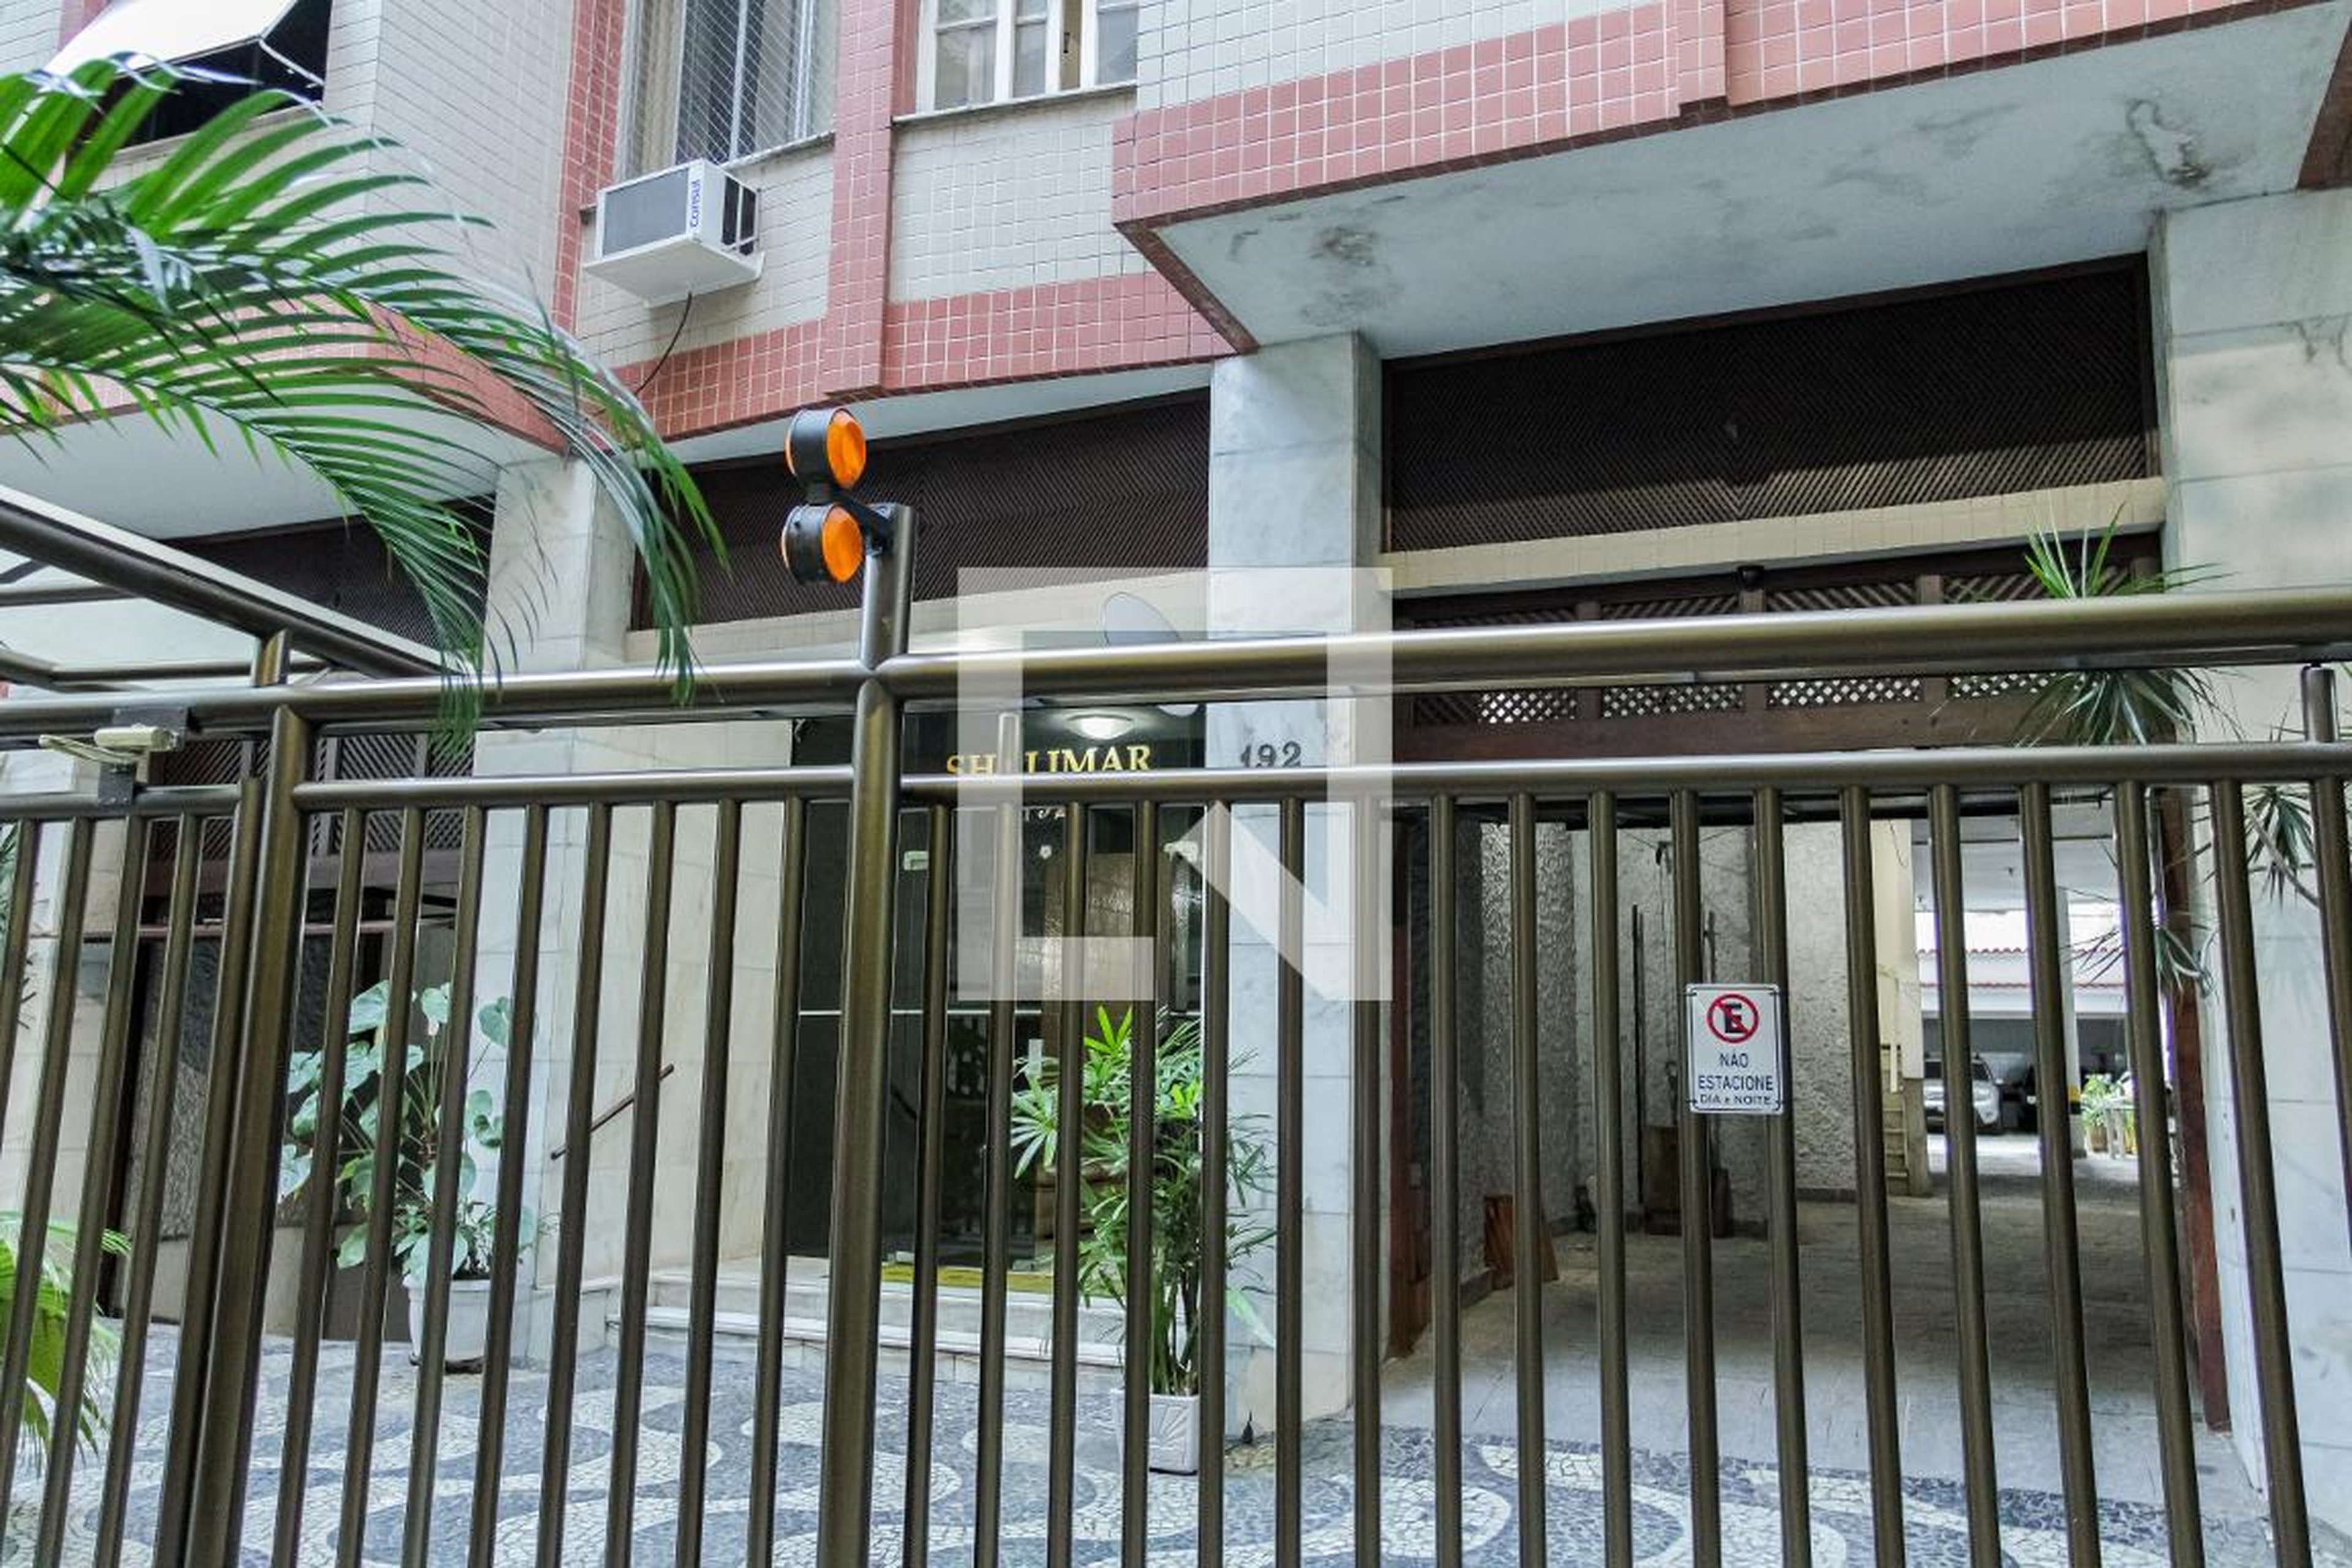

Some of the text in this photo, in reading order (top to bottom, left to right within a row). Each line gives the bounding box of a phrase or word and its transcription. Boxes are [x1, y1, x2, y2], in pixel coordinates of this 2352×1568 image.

[946, 745, 1151, 775] SHLIMAR
[1698, 1075, 1773, 1090] ESTACIONE
[1700, 1094, 1721, 1103] DIA
[1735, 1095, 1773, 1105] NOITE
